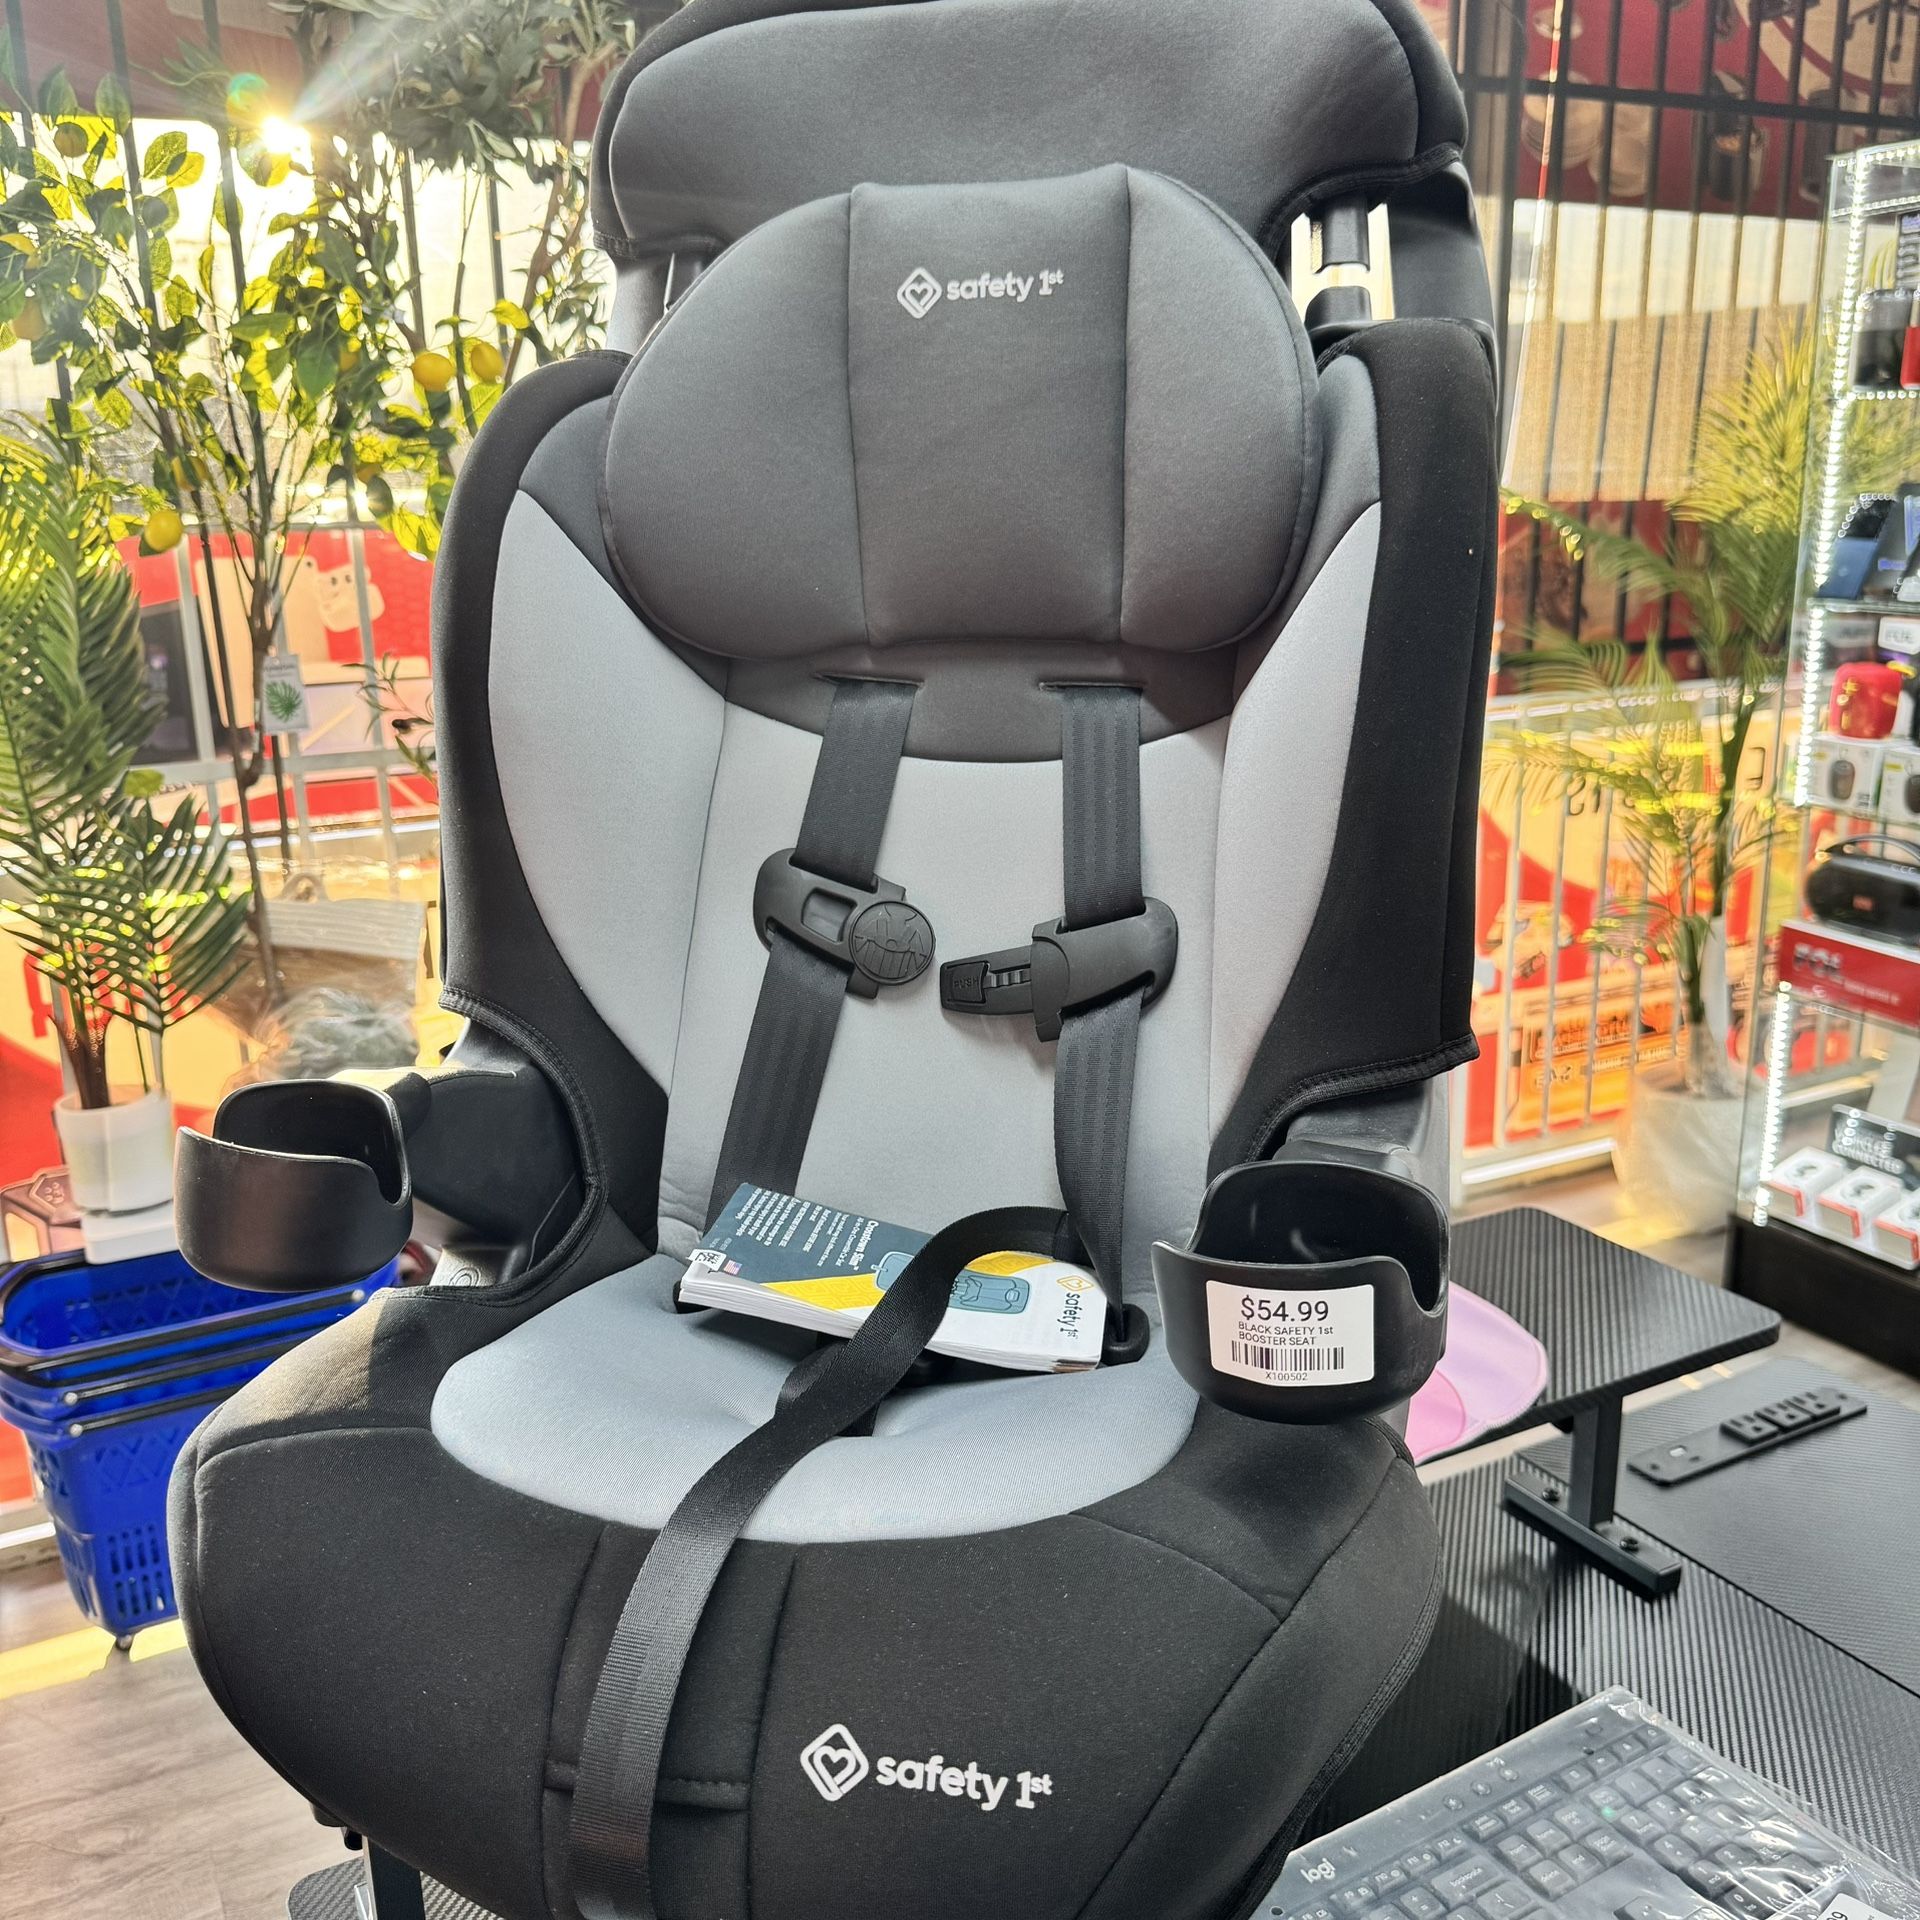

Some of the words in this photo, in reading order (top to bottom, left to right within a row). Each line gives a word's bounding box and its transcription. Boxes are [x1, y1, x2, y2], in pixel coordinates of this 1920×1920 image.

[946, 272, 1035, 303] safety
[1038, 268, 1064, 296] 1st
[854, 1220, 879, 1252] Crosstown
[1056, 1292, 1084, 1328] safety
[1240, 1294, 1329, 1322] $54.99
[1238, 1321, 1272, 1335] BLACK
[1274, 1326, 1316, 1336] SAFETY
[1318, 1325, 1334, 1335] 1st
[1238, 1331, 1287, 1346] BOOSTER
[1288, 1336, 1316, 1346] SEAT
[1265, 1372, 1308, 1382] X100502
[875, 1754, 1009, 1811] safety
[1015, 1770, 1053, 1809] 1st
[1300, 1857, 1336, 1884] logi
